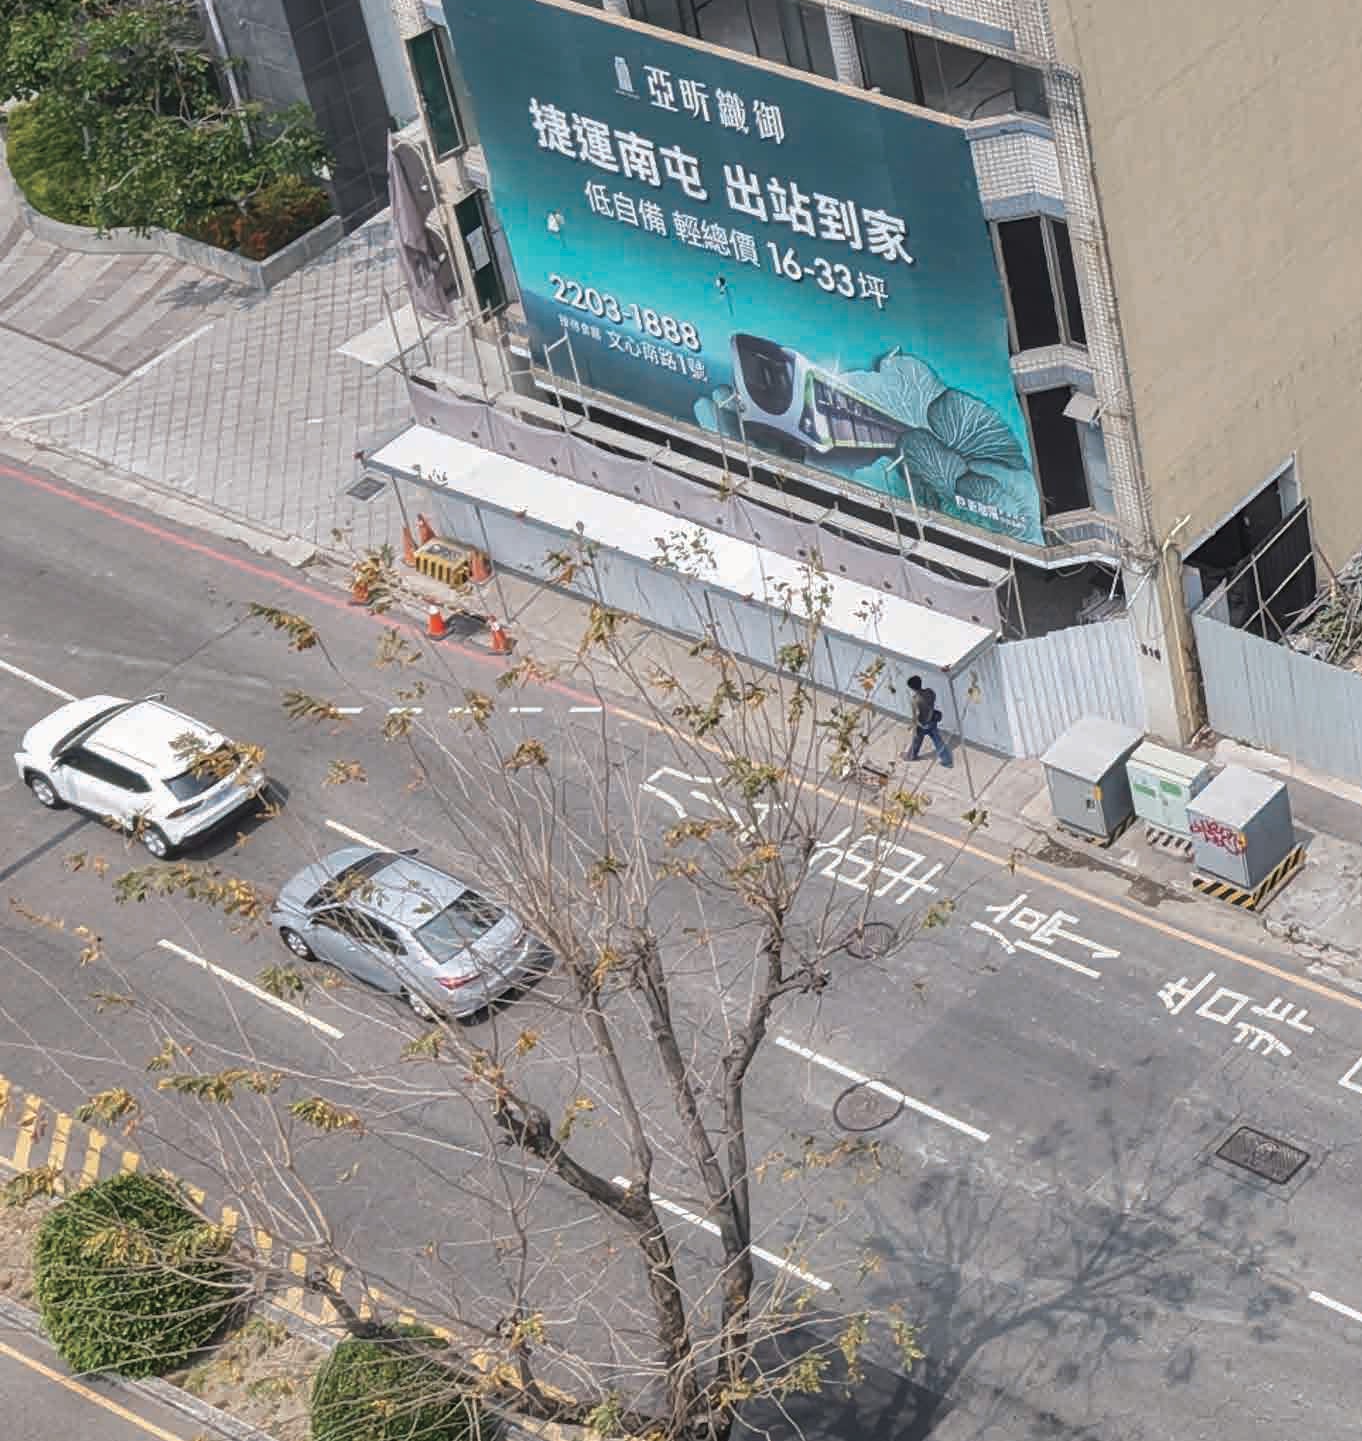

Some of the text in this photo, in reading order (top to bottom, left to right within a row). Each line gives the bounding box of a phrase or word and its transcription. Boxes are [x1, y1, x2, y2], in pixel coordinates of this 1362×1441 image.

[528, 97, 914, 265] 捷運南屯 出站到家
[584, 179, 890, 311] 低自備 輕總價 16-33坪
[549, 273, 701, 352] 2203-1888
